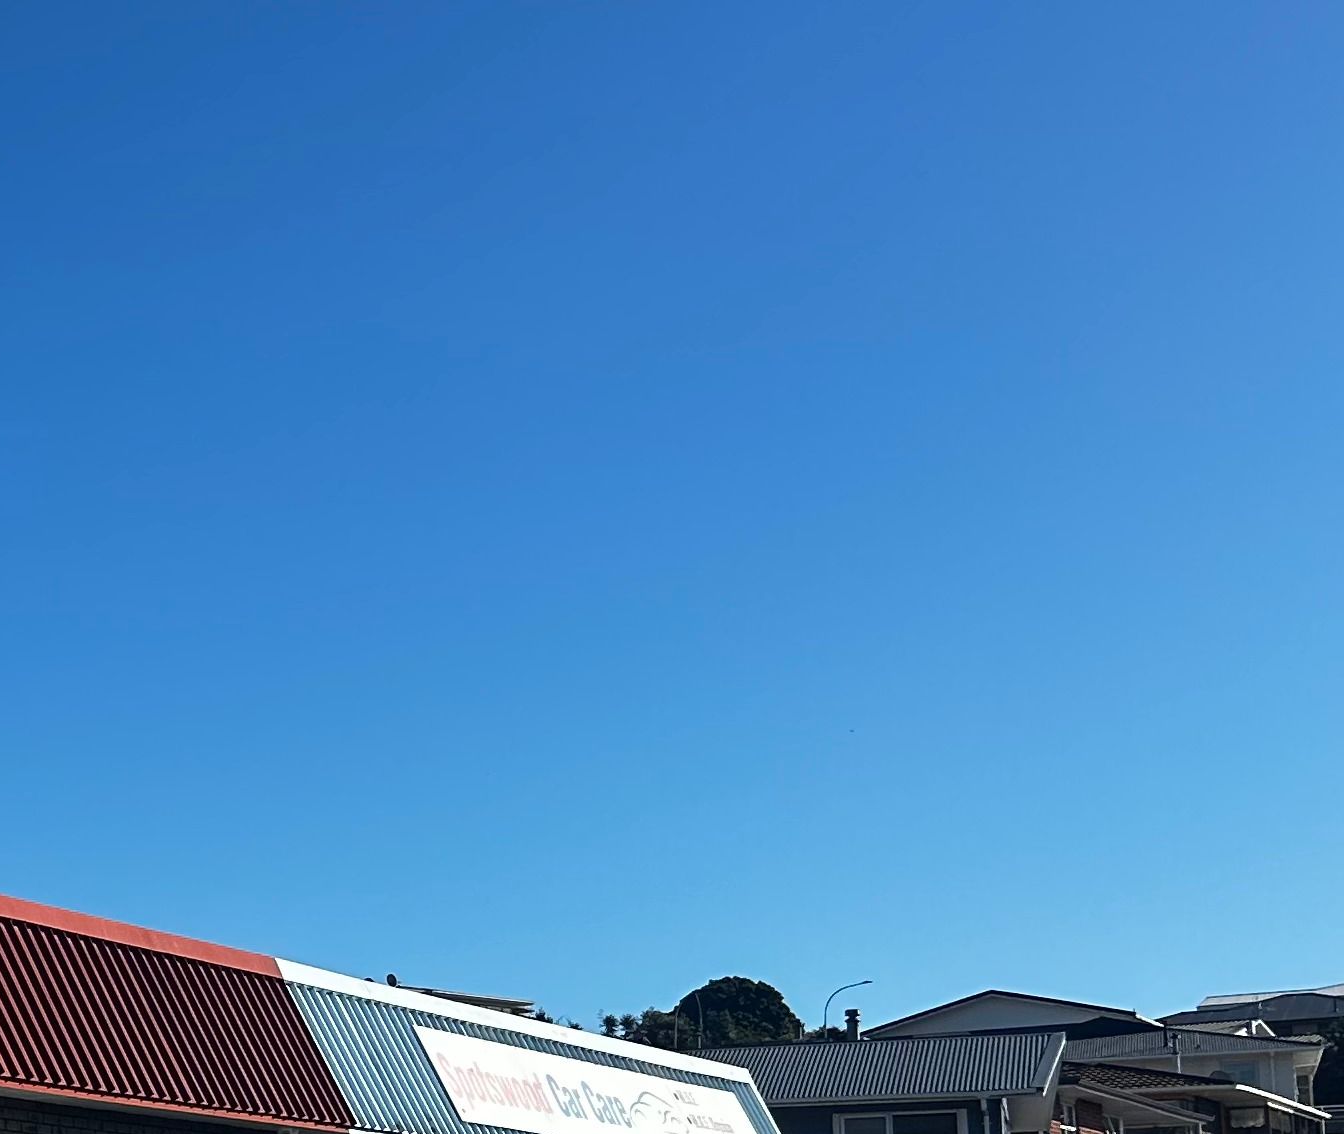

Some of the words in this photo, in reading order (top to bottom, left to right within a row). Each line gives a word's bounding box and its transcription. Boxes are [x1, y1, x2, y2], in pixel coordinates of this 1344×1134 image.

[436, 1051, 554, 1114] Spotswood
[545, 1073, 589, 1120] Car
[580, 1080, 633, 1129] Care
